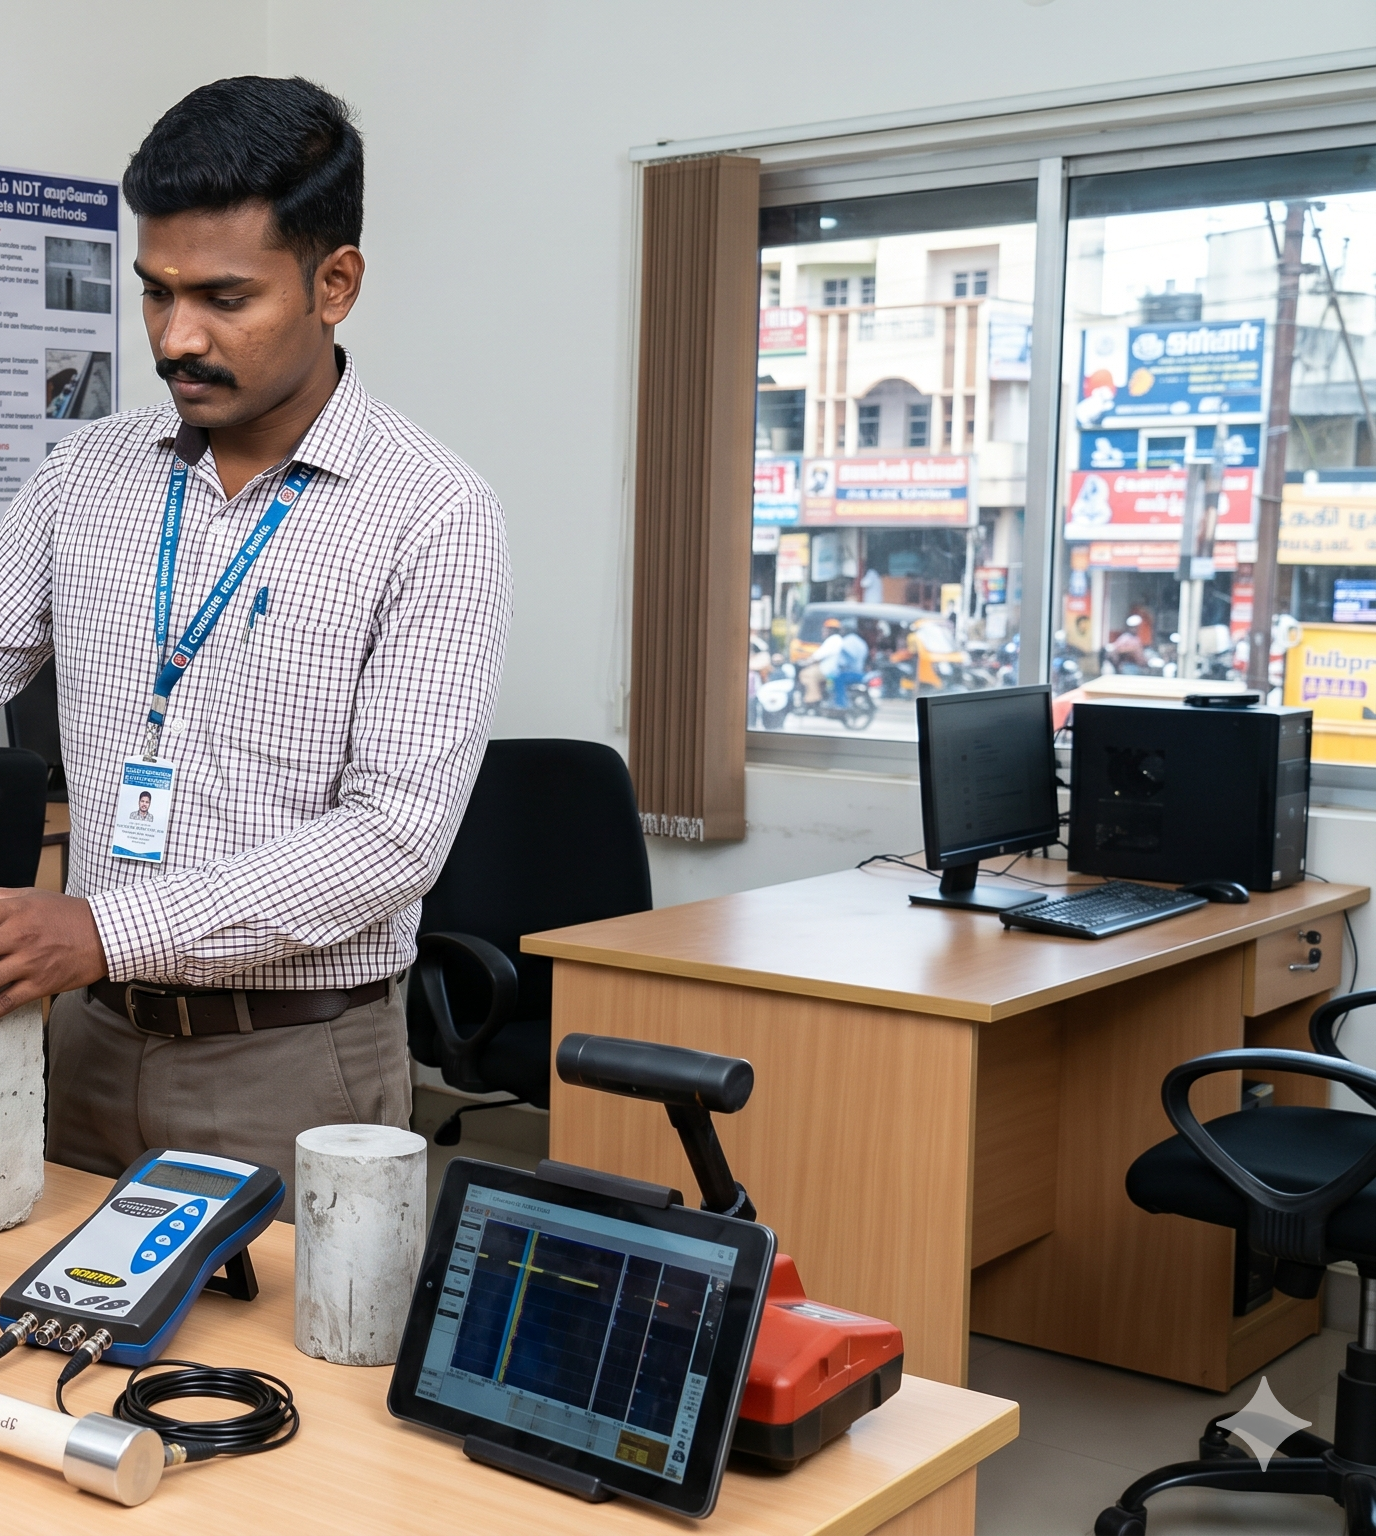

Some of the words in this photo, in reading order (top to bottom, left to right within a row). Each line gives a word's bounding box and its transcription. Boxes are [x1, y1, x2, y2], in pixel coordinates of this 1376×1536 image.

[12, 179, 42, 197] NDT
[16, 200, 40, 216] NDT
[42, 203, 87, 222] Methods
